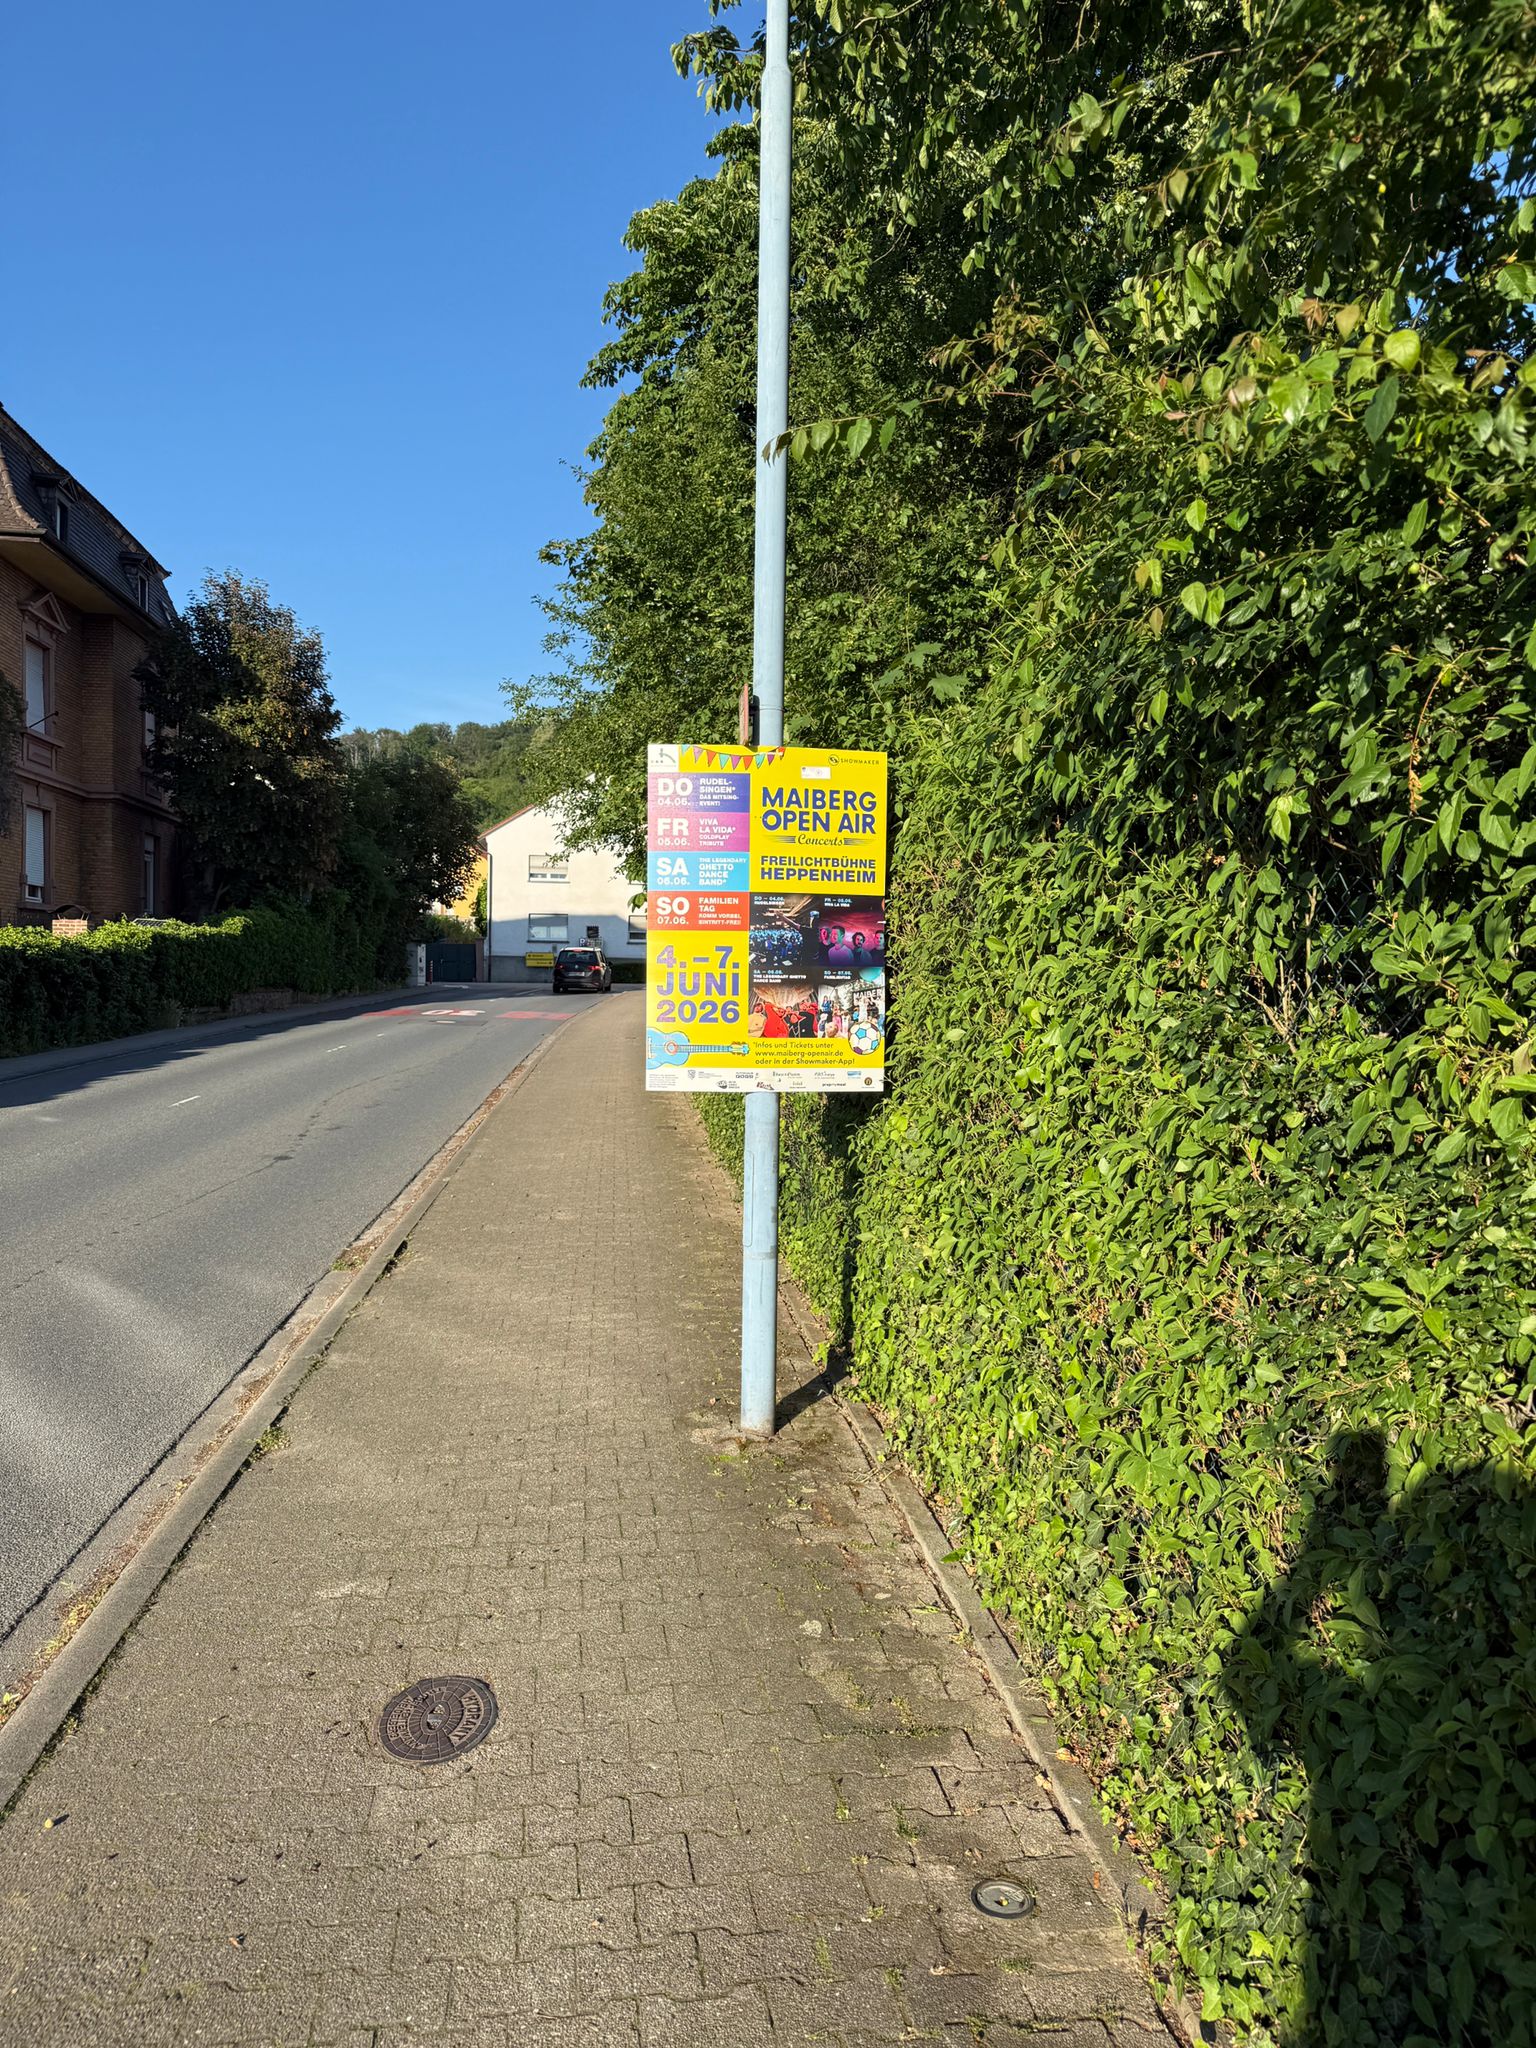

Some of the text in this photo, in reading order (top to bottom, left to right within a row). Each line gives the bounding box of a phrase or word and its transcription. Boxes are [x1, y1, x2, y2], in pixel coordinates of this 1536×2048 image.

[657, 778, 693, 796] DO
[657, 797, 691, 806] 04.06.
[762, 787, 877, 812] MAIBERG
[657, 818, 689, 836] FR
[762, 810, 876, 834] OPEN AIR
[657, 838, 690, 846] 05.06.
[798, 834, 843, 846] Concerts
[656, 857, 689, 876] SA
[761, 855, 876, 869] FREILICHTBÜHNE
[657, 877, 690, 885] 06.06.
[761, 867, 876, 883] HEPPENHEIM
[656, 896, 690, 915] SO
[657, 916, 689, 925] 07.06.
[657, 972, 739, 996] JUNI
[656, 999, 740, 1023] 2026
[388, 1698, 412, 1740] HEIDELBERG
[451, 1694, 482, 1742] HYDRANT
